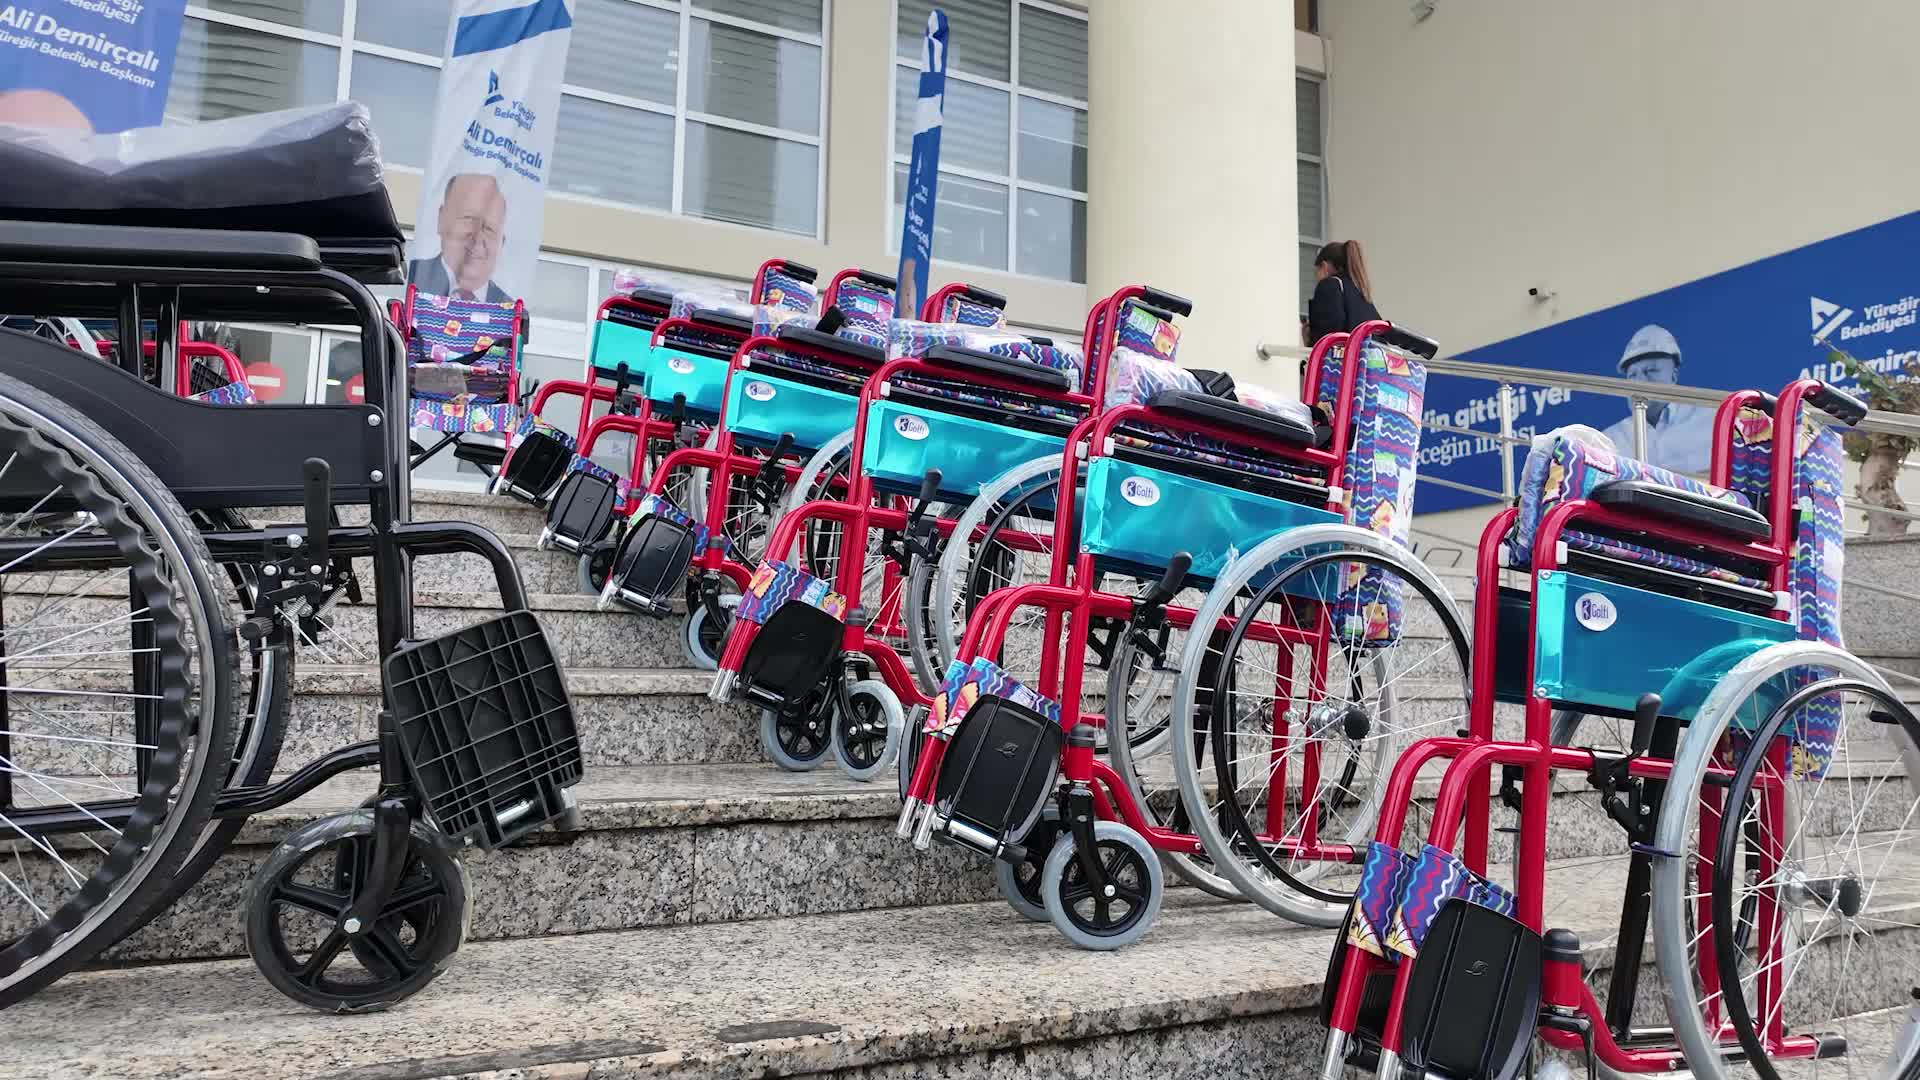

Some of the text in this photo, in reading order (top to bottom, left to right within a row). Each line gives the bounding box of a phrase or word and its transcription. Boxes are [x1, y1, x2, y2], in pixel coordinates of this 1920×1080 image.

[65, 0, 138, 24] elediyesi
[0, 6, 159, 72] Ali Demirçalı
[0, 30, 156, 88] üreğir Belediye Başkanı
[467, 120, 543, 168] Ali Demirçalı
[1841, 310, 1917, 340] Belediyesi
